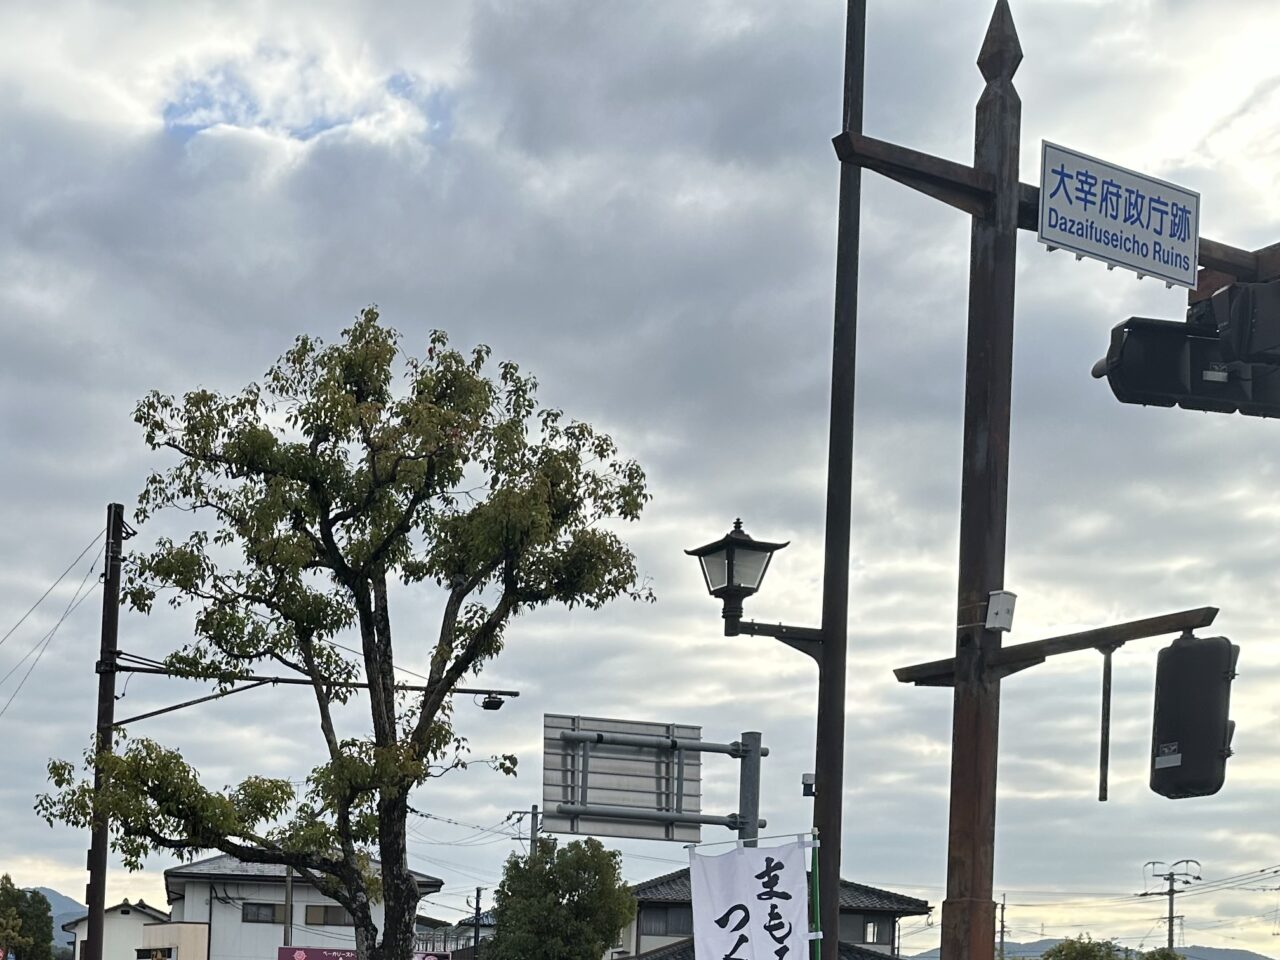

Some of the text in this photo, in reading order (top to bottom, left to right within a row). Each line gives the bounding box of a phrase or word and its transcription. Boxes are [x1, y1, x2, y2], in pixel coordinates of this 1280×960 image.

[1048, 207, 1190, 271] Dazaifuseicho Ruins
[1049, 163, 1192, 243] 大宰府政庁跡
